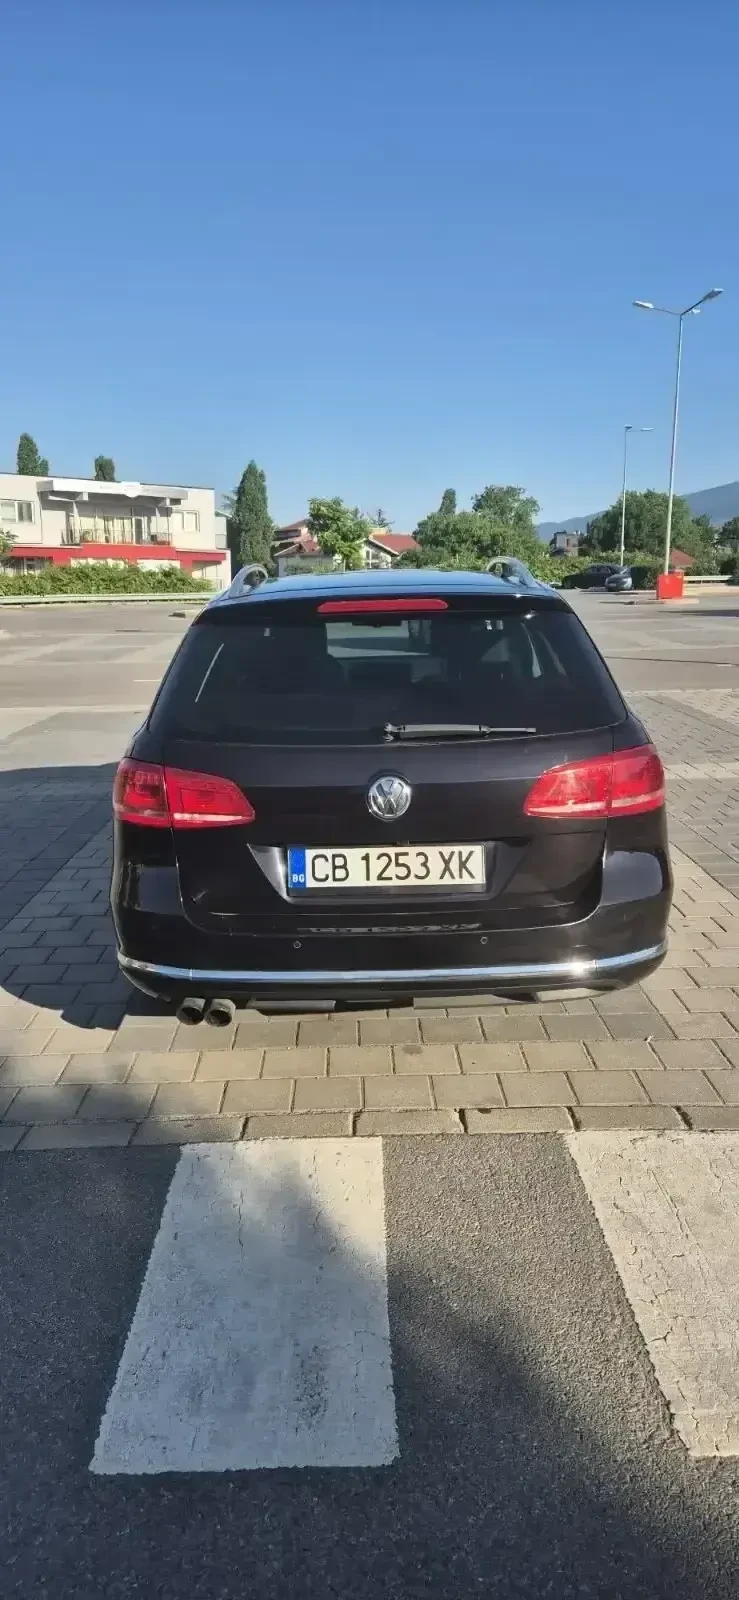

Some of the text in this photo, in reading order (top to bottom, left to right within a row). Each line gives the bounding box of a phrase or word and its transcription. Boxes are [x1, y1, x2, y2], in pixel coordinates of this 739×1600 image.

[369, 778, 410, 818] VW
[292, 874, 305, 883] BG
[311, 850, 476, 882] CB 1253 XK
